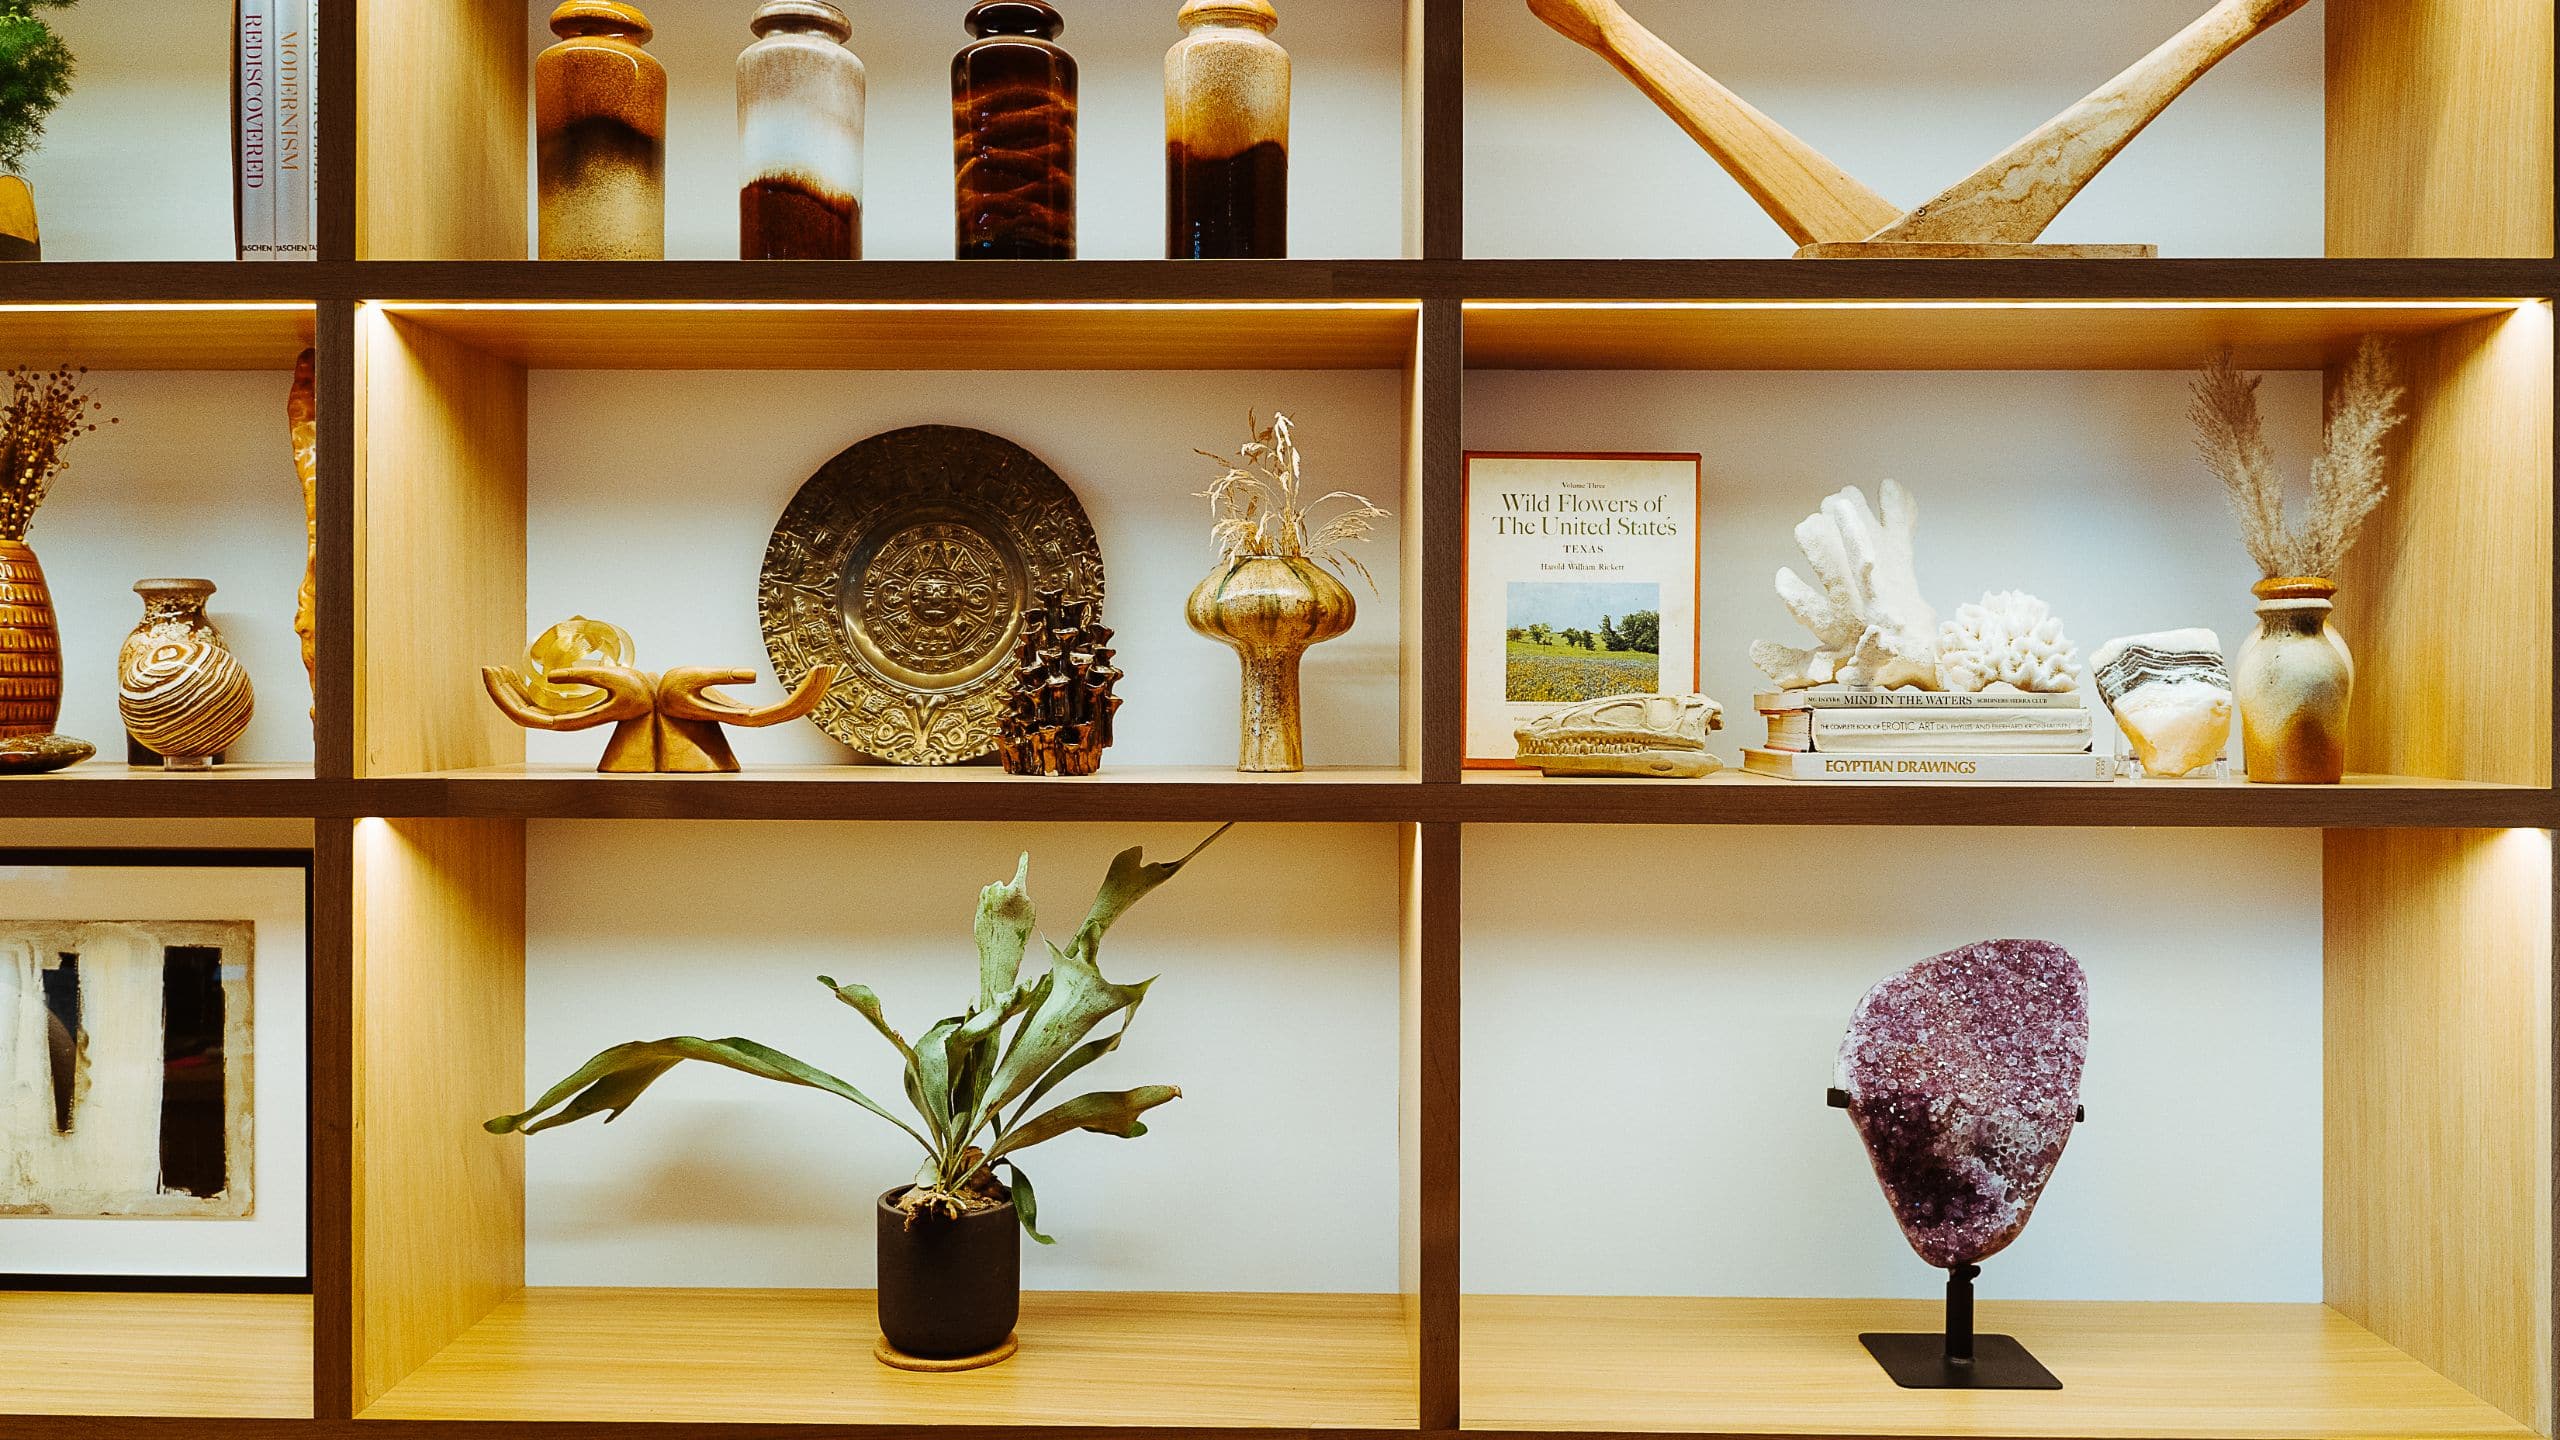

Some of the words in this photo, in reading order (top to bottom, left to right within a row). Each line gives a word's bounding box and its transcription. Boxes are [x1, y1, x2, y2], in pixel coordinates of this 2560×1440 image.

[245, 14, 264, 188] REDISCOVERED
[280, 31, 298, 171] MODERNISM
[276, 244, 307, 252] TASCHEN
[1501, 493, 1550, 513] Wild
[1558, 494, 1638, 513] Flowers
[1643, 494, 1667, 513] of
[1492, 516, 1536, 535] The
[1541, 516, 1611, 536] United
[1617, 516, 1677, 536] States
[1563, 544, 1604, 554] TEXAS
[1541, 563, 1565, 571] Harold
[1568, 563, 1596, 571] William
[1844, 695, 1878, 705] MIND
[1881, 695, 1894, 705] IN
[1897, 695, 1923, 705] THE
[1925, 695, 1973, 705] WATERS
[1881, 721, 1915, 731] EROTIC
[1918, 721, 1936, 731] ART
[1825, 760, 1893, 773] EGYPTIAN
[1897, 760, 1976, 774] DRAWINGS
